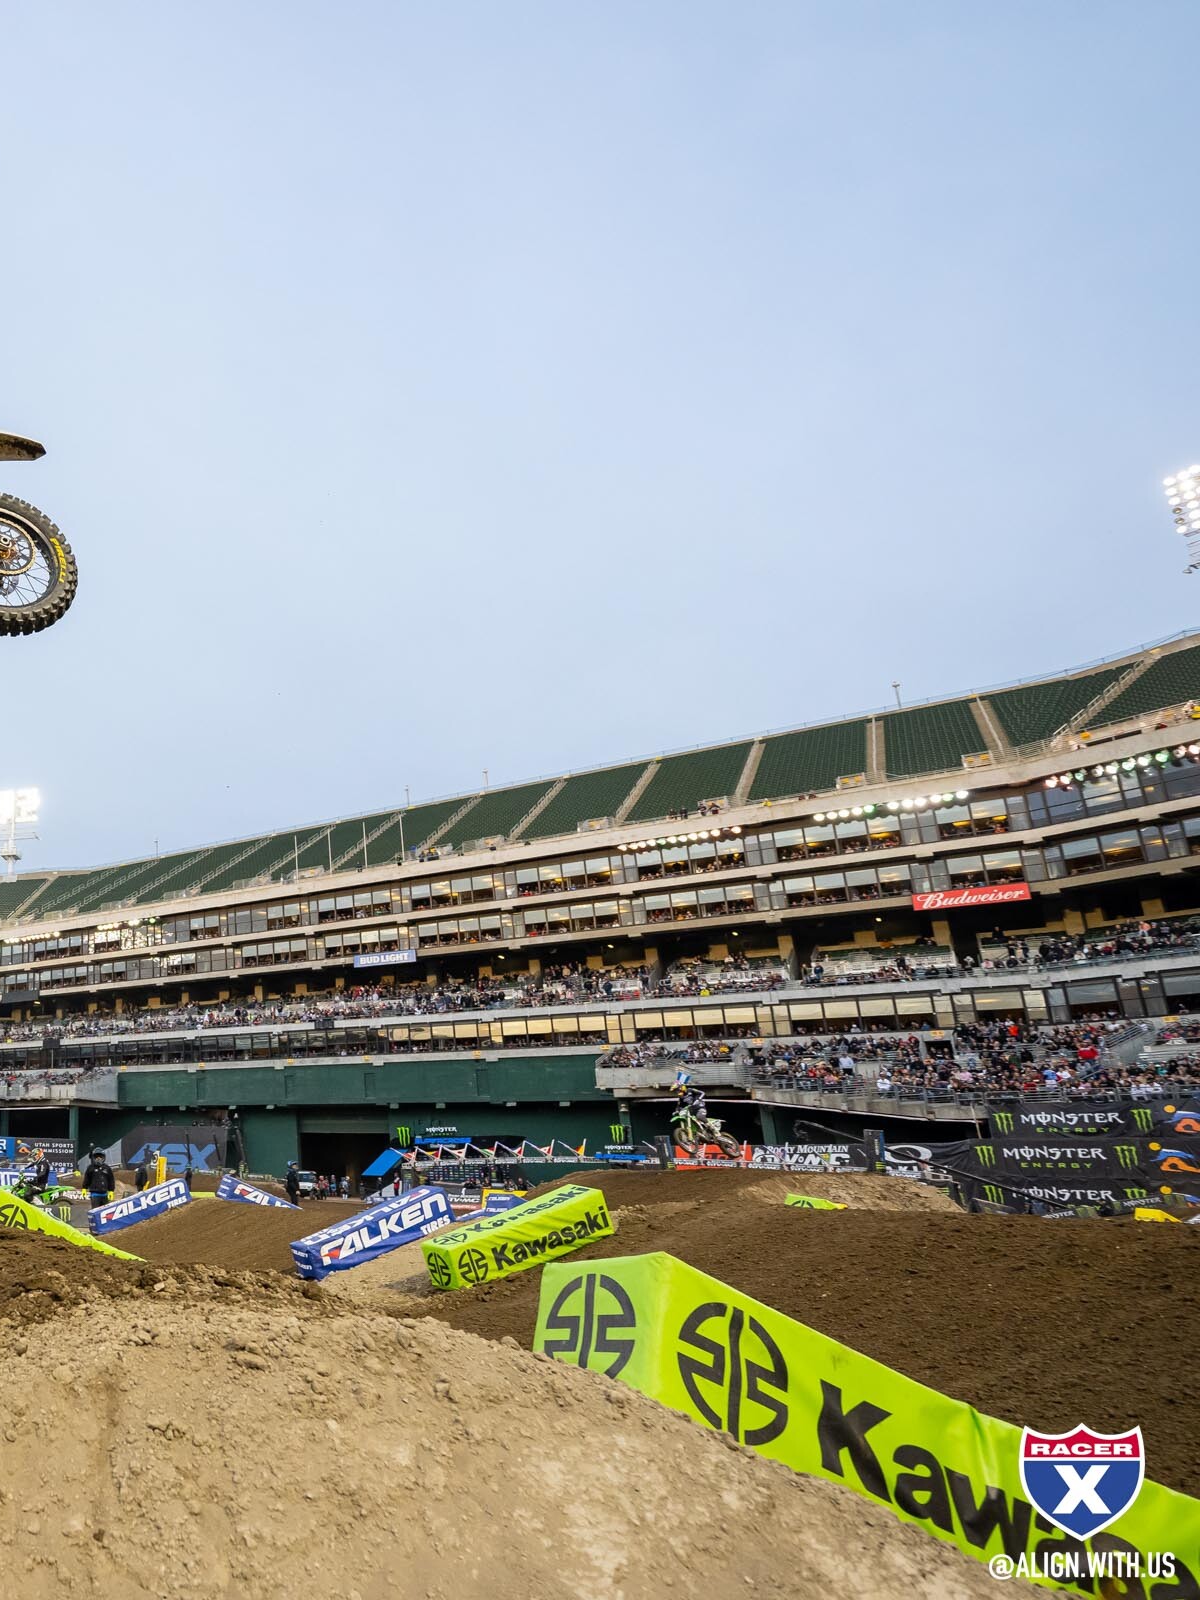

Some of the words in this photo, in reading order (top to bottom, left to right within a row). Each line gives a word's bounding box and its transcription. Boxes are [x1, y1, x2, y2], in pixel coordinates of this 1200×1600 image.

[50, 537, 67, 583] PIRELLI
[917, 886, 1025, 909] Budweiser
[359, 955, 379, 966] BUD
[380, 952, 411, 964] LIGHT
[1020, 1111, 1125, 1126] MONSTER
[767, 1145, 797, 1154] ROCKY
[797, 1144, 849, 1154] MOUNTAIN
[1003, 1145, 1108, 1160] MONSTER
[100, 1181, 186, 1225] FALKEN
[167, 1195, 188, 1209] TIRES
[234, 1183, 291, 1208] FAL
[466, 1185, 591, 1233] Kawasaki
[320, 1193, 448, 1266] FALKEN
[420, 1214, 451, 1235] TIRES
[491, 1206, 609, 1271] Kawasaki
